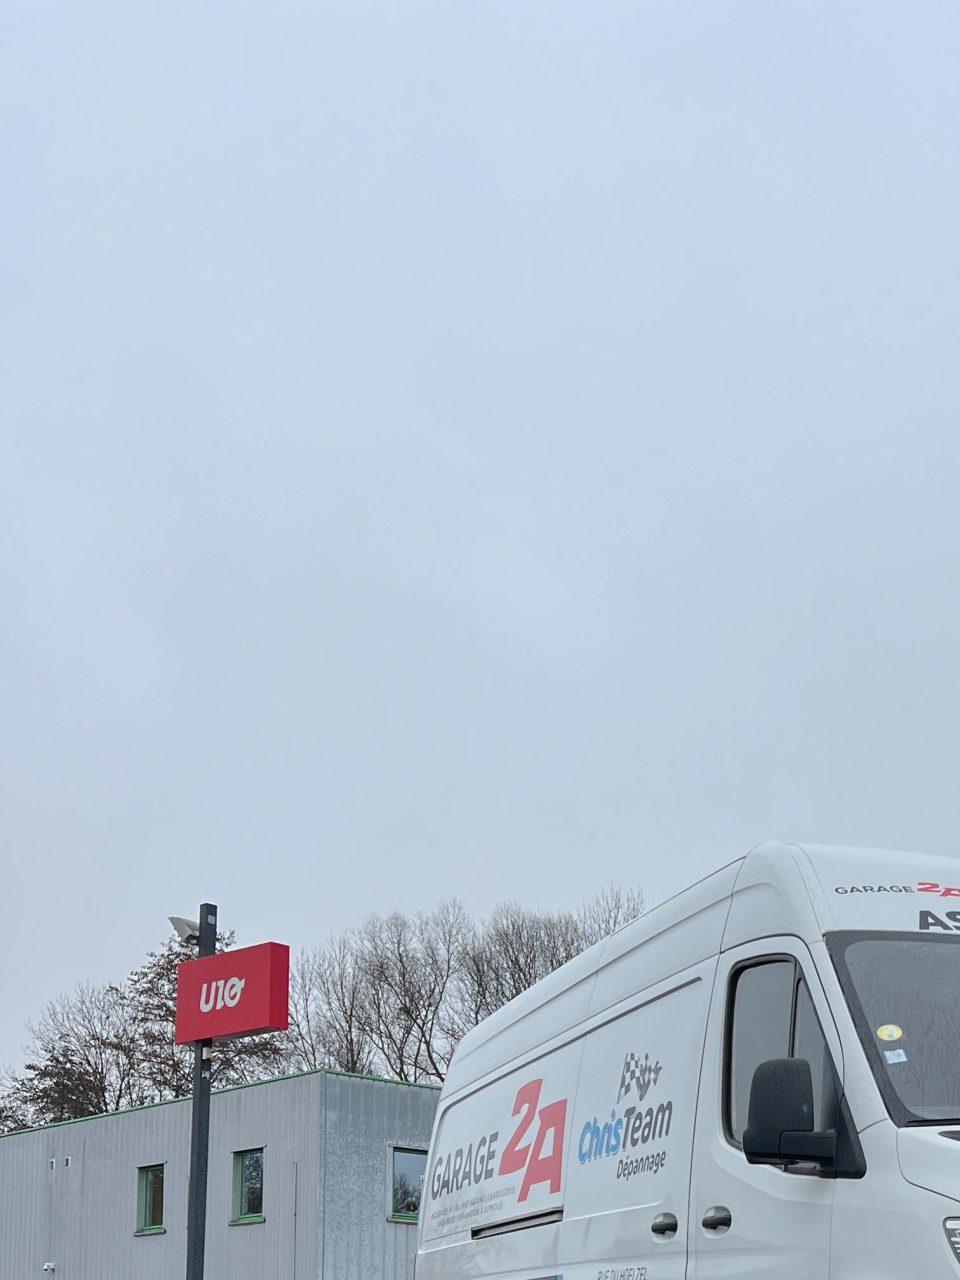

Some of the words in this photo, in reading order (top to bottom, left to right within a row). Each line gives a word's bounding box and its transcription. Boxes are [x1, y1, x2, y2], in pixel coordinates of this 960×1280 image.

[834, 885, 915, 895] GARAGE
[431, 1131, 499, 1200] GARAGE
[498, 1078, 568, 1203] 2A
[616, 1150, 666, 1180] Dépannage
